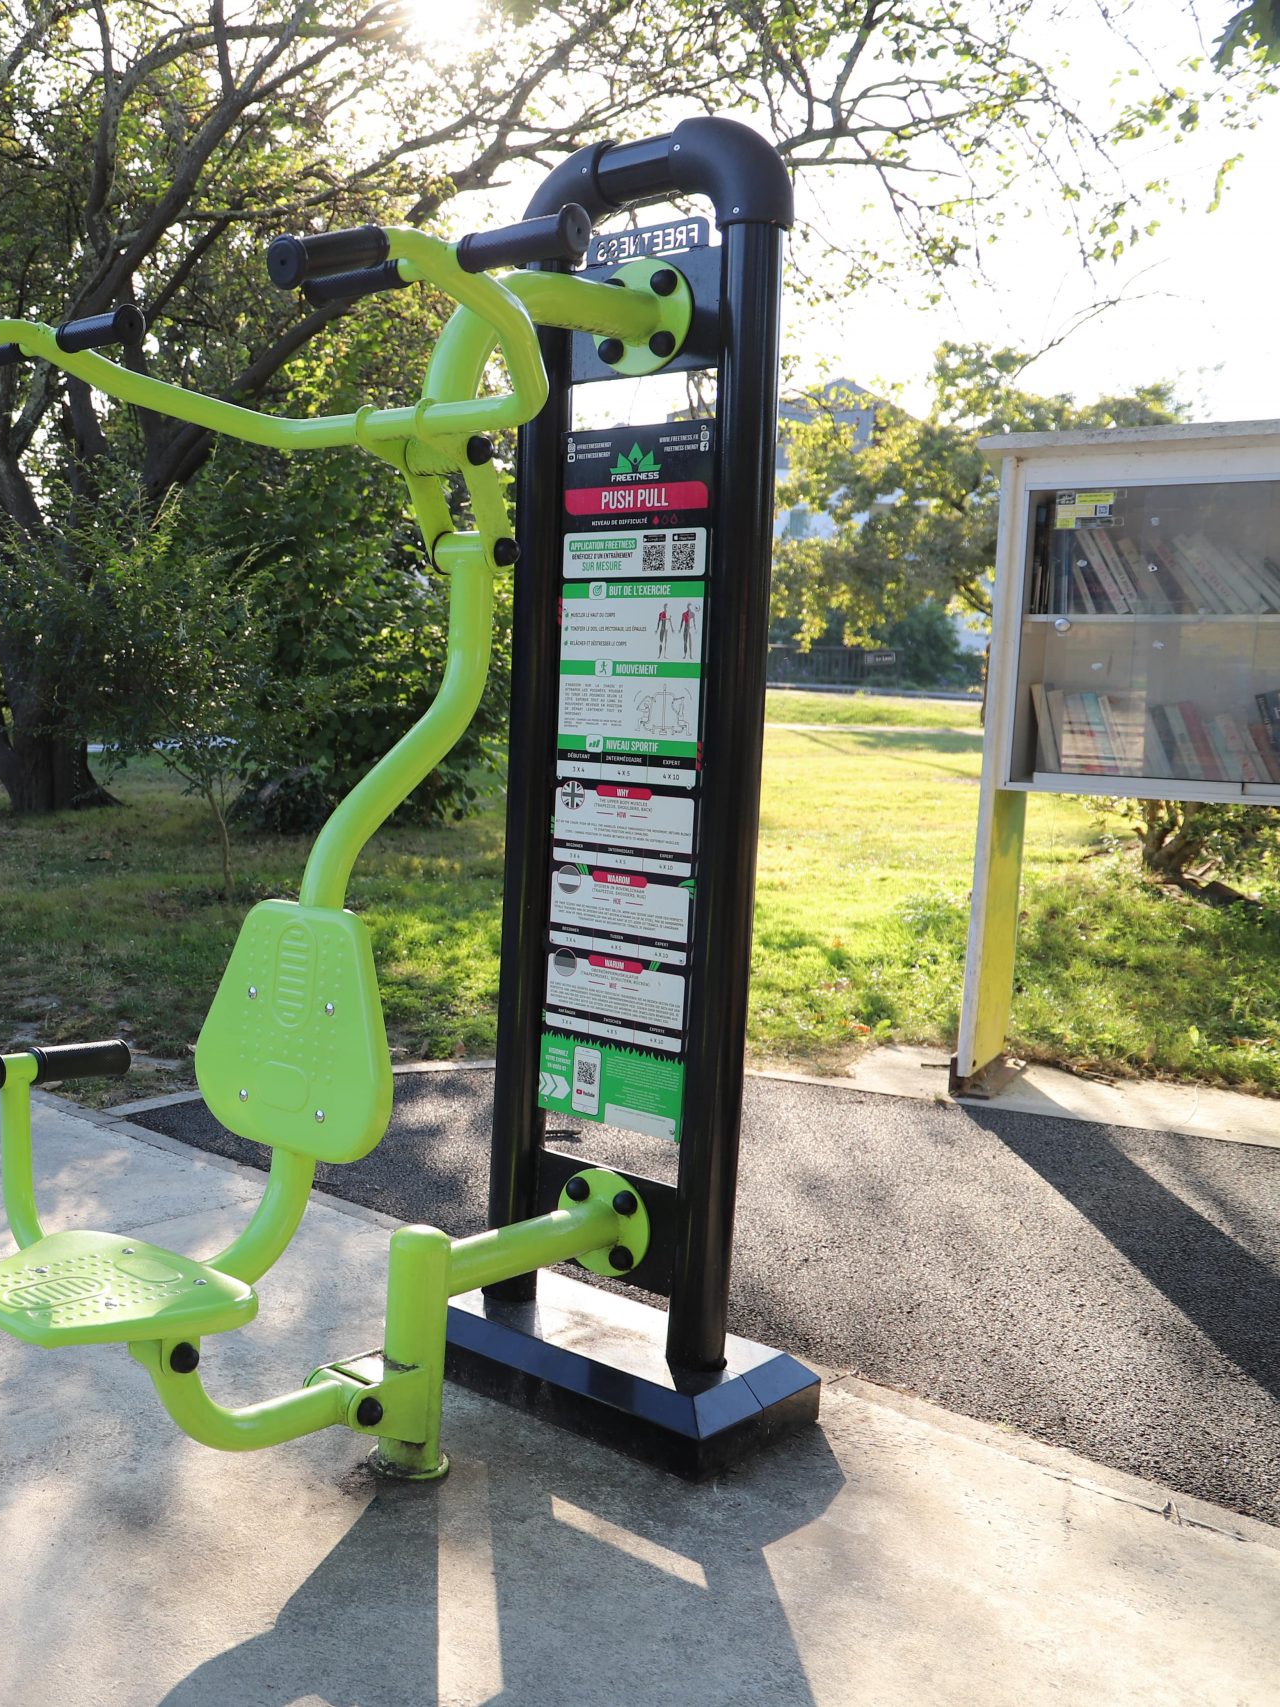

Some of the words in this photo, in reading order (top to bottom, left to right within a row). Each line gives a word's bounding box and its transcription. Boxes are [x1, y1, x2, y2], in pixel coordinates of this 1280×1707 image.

[611, 471, 659, 482] FREETNESS
[601, 490, 634, 509] PUSH
[637, 487, 668, 507] PULL
[618, 517, 648, 525] DIFFICULTÉ
[571, 541, 604, 551] APPLICATION
[605, 540, 635, 549] FREETNESS
[582, 561, 595, 571] SUR
[596, 561, 622, 570] MESURE
[609, 586, 622, 595] BUT
[624, 586, 632, 595] DE
[633, 585, 671, 595] L'EXERCICE
[616, 664, 658, 675] MOUVEMENT
[606, 739, 629, 750] NIVEAU
[631, 741, 658, 752] SPORTIF
[606, 754, 642, 763] INTERMÉDIAIRE
[617, 788, 629, 797] WHY
[607, 874, 630, 884] WAAROM
[604, 959, 624, 969] WARUM
